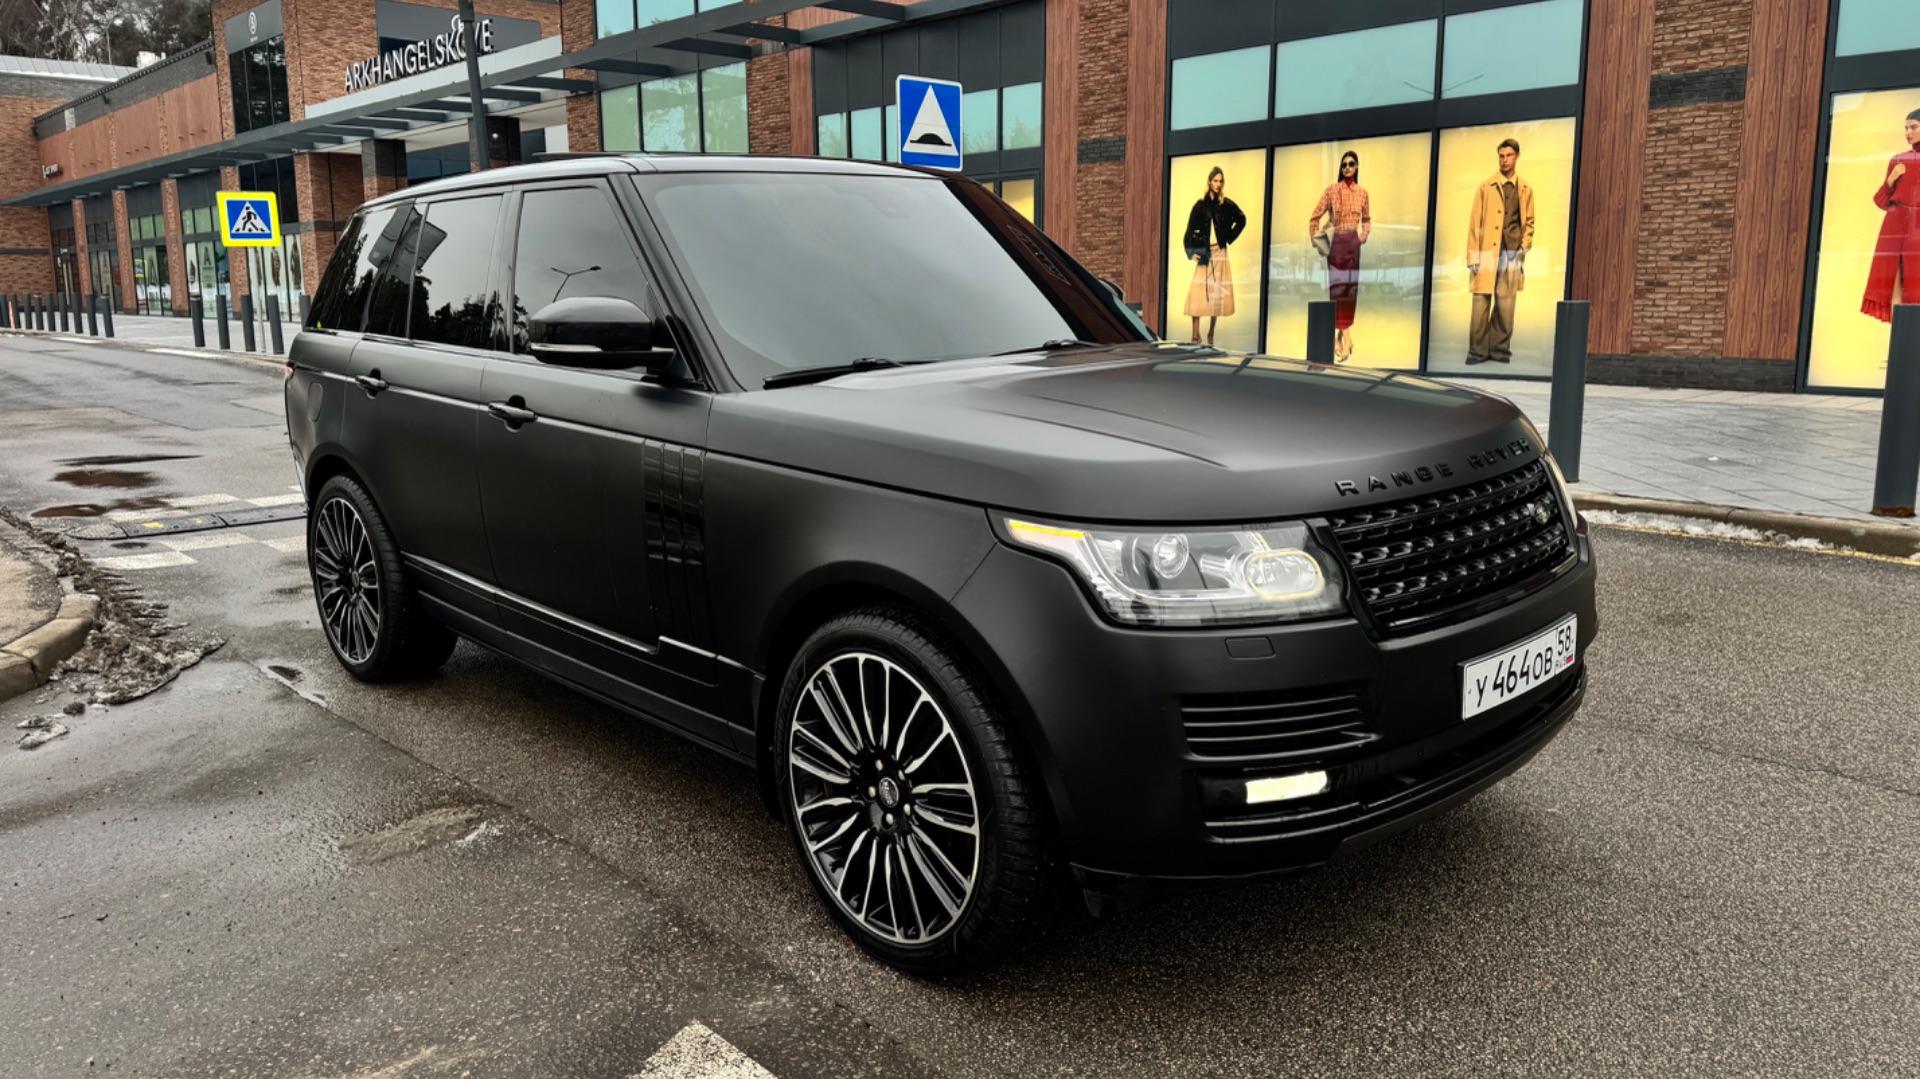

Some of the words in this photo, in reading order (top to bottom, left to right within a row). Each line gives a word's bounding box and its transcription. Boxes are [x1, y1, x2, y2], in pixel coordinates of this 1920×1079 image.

[1335, 462, 1454, 497] RANGE
[1466, 437, 1531, 470] ROVER
[1558, 625, 1571, 657] 58
